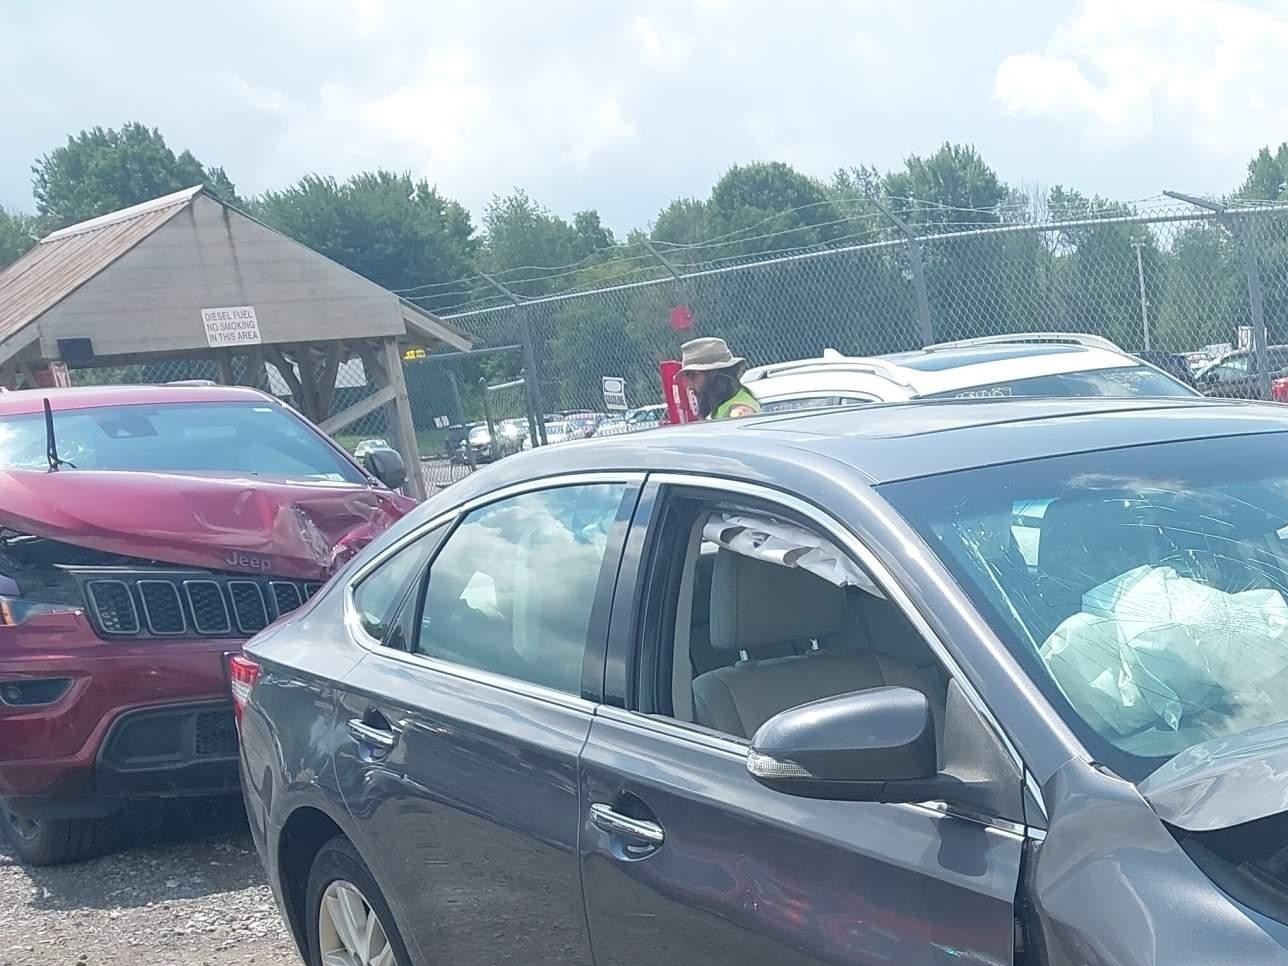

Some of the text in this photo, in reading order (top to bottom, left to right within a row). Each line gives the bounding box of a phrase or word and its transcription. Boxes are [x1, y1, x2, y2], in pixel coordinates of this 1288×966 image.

[205, 310, 253, 321] DIESEL FUEL
[207, 320, 255, 331] NO SMOKING
[209, 331, 258, 342] IN THIS AREA
[224, 552, 271, 572] Jeep
